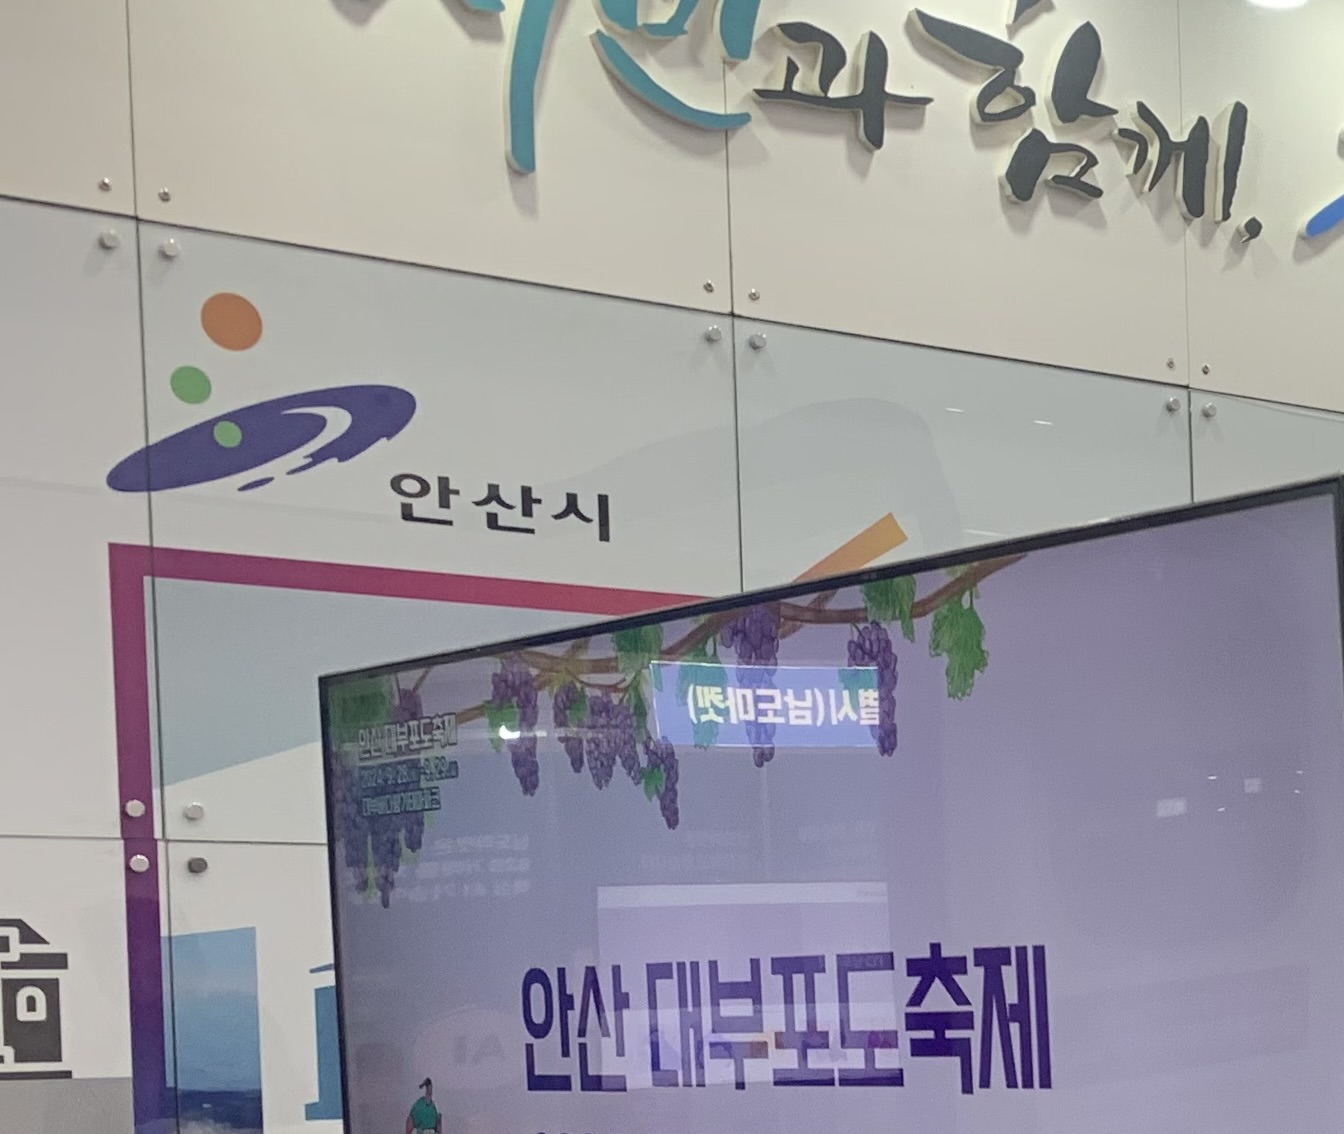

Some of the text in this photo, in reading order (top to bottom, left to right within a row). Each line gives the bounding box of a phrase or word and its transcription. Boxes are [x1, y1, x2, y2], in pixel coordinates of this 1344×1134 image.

[455, 0, 934, 173] 민과
[390, 472, 611, 542] 안산시
[522, 942, 1052, 1094] 안산 대부포도축제
